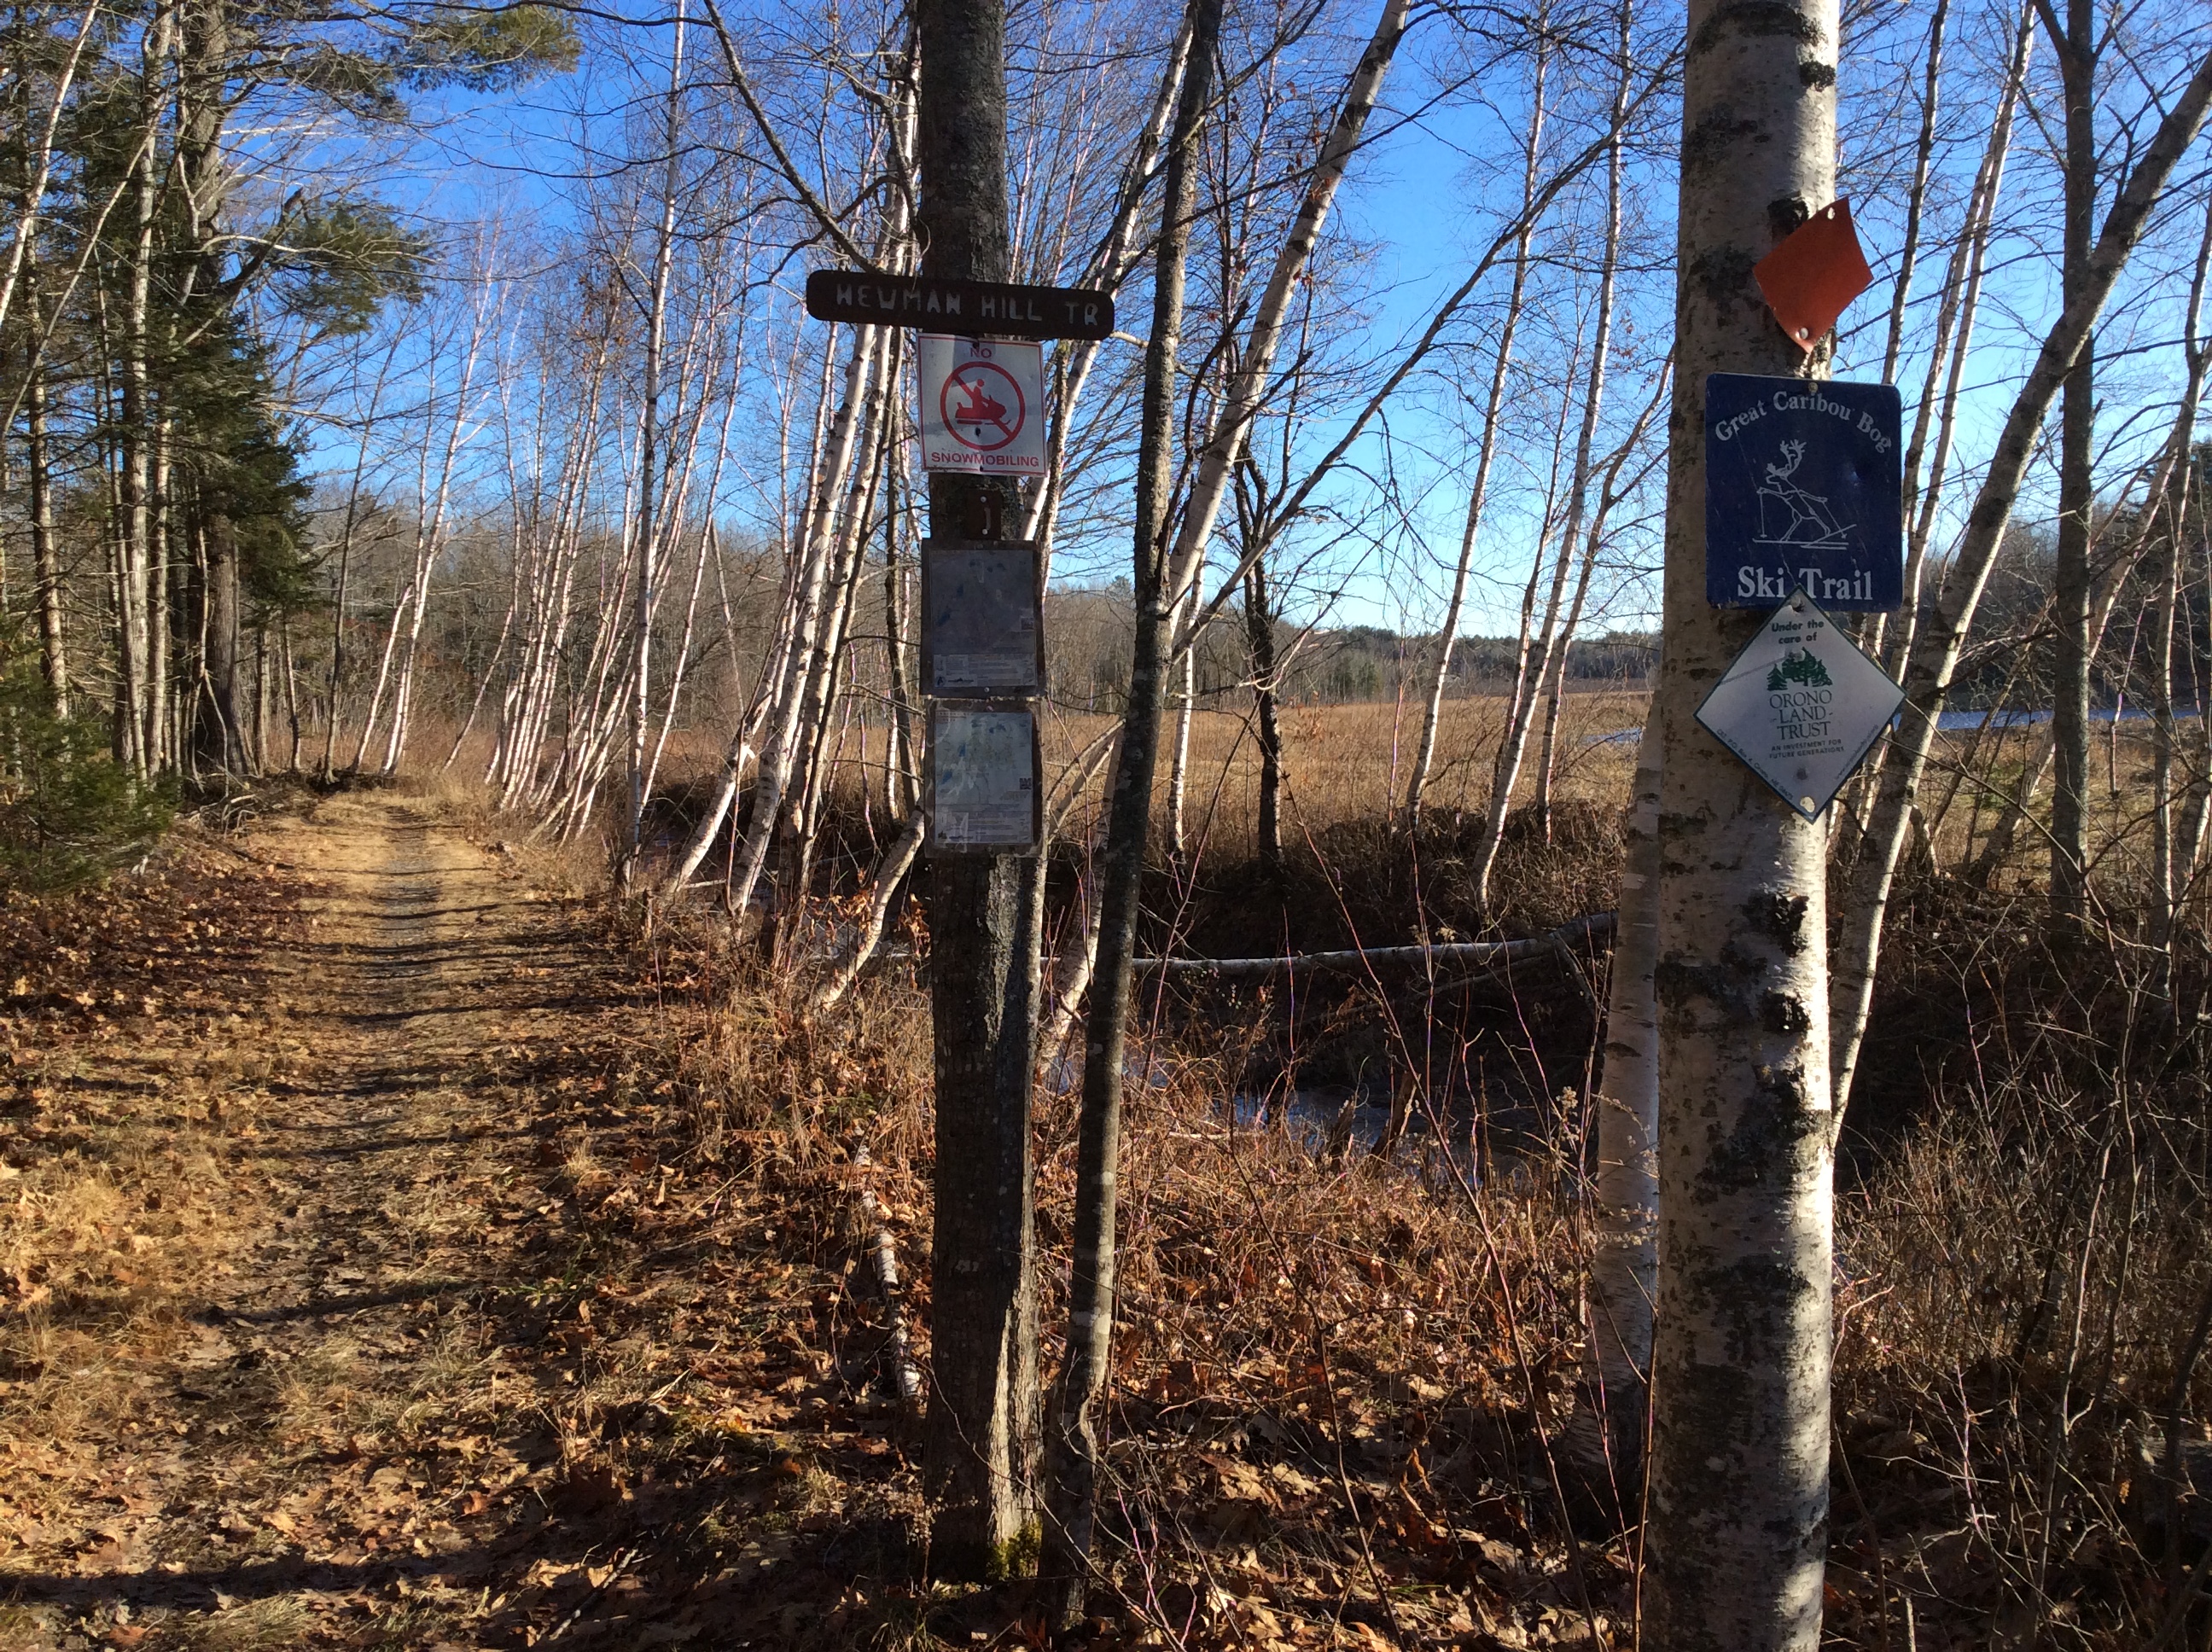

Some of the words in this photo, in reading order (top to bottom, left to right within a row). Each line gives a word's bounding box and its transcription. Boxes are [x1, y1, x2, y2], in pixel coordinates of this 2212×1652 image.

[836, 283, 961, 315] NEWMAN
[981, 298, 1042, 322] HILL
[1065, 301, 1098, 326] TR
[970, 347, 992, 358] NO
[1715, 400, 1767, 441] Great
[1773, 391, 1850, 421] Caribou
[1856, 411, 1892, 453] Bog
[931, 451, 1039, 467] SNOWMOBILING
[1738, 566, 1786, 598] Ski
[1799, 568, 1873, 600] Trail
[1772, 621, 1803, 632] Under
[1807, 619, 1825, 629] the
[1778, 636, 1802, 644] care
[1806, 631, 1818, 642] of
[1769, 689, 1832, 709] ORONO
[1777, 721, 1831, 740] TRUST
[1784, 740, 1826, 750] INVESTMENT
[1797, 747, 1844, 757] GENERATIONS
